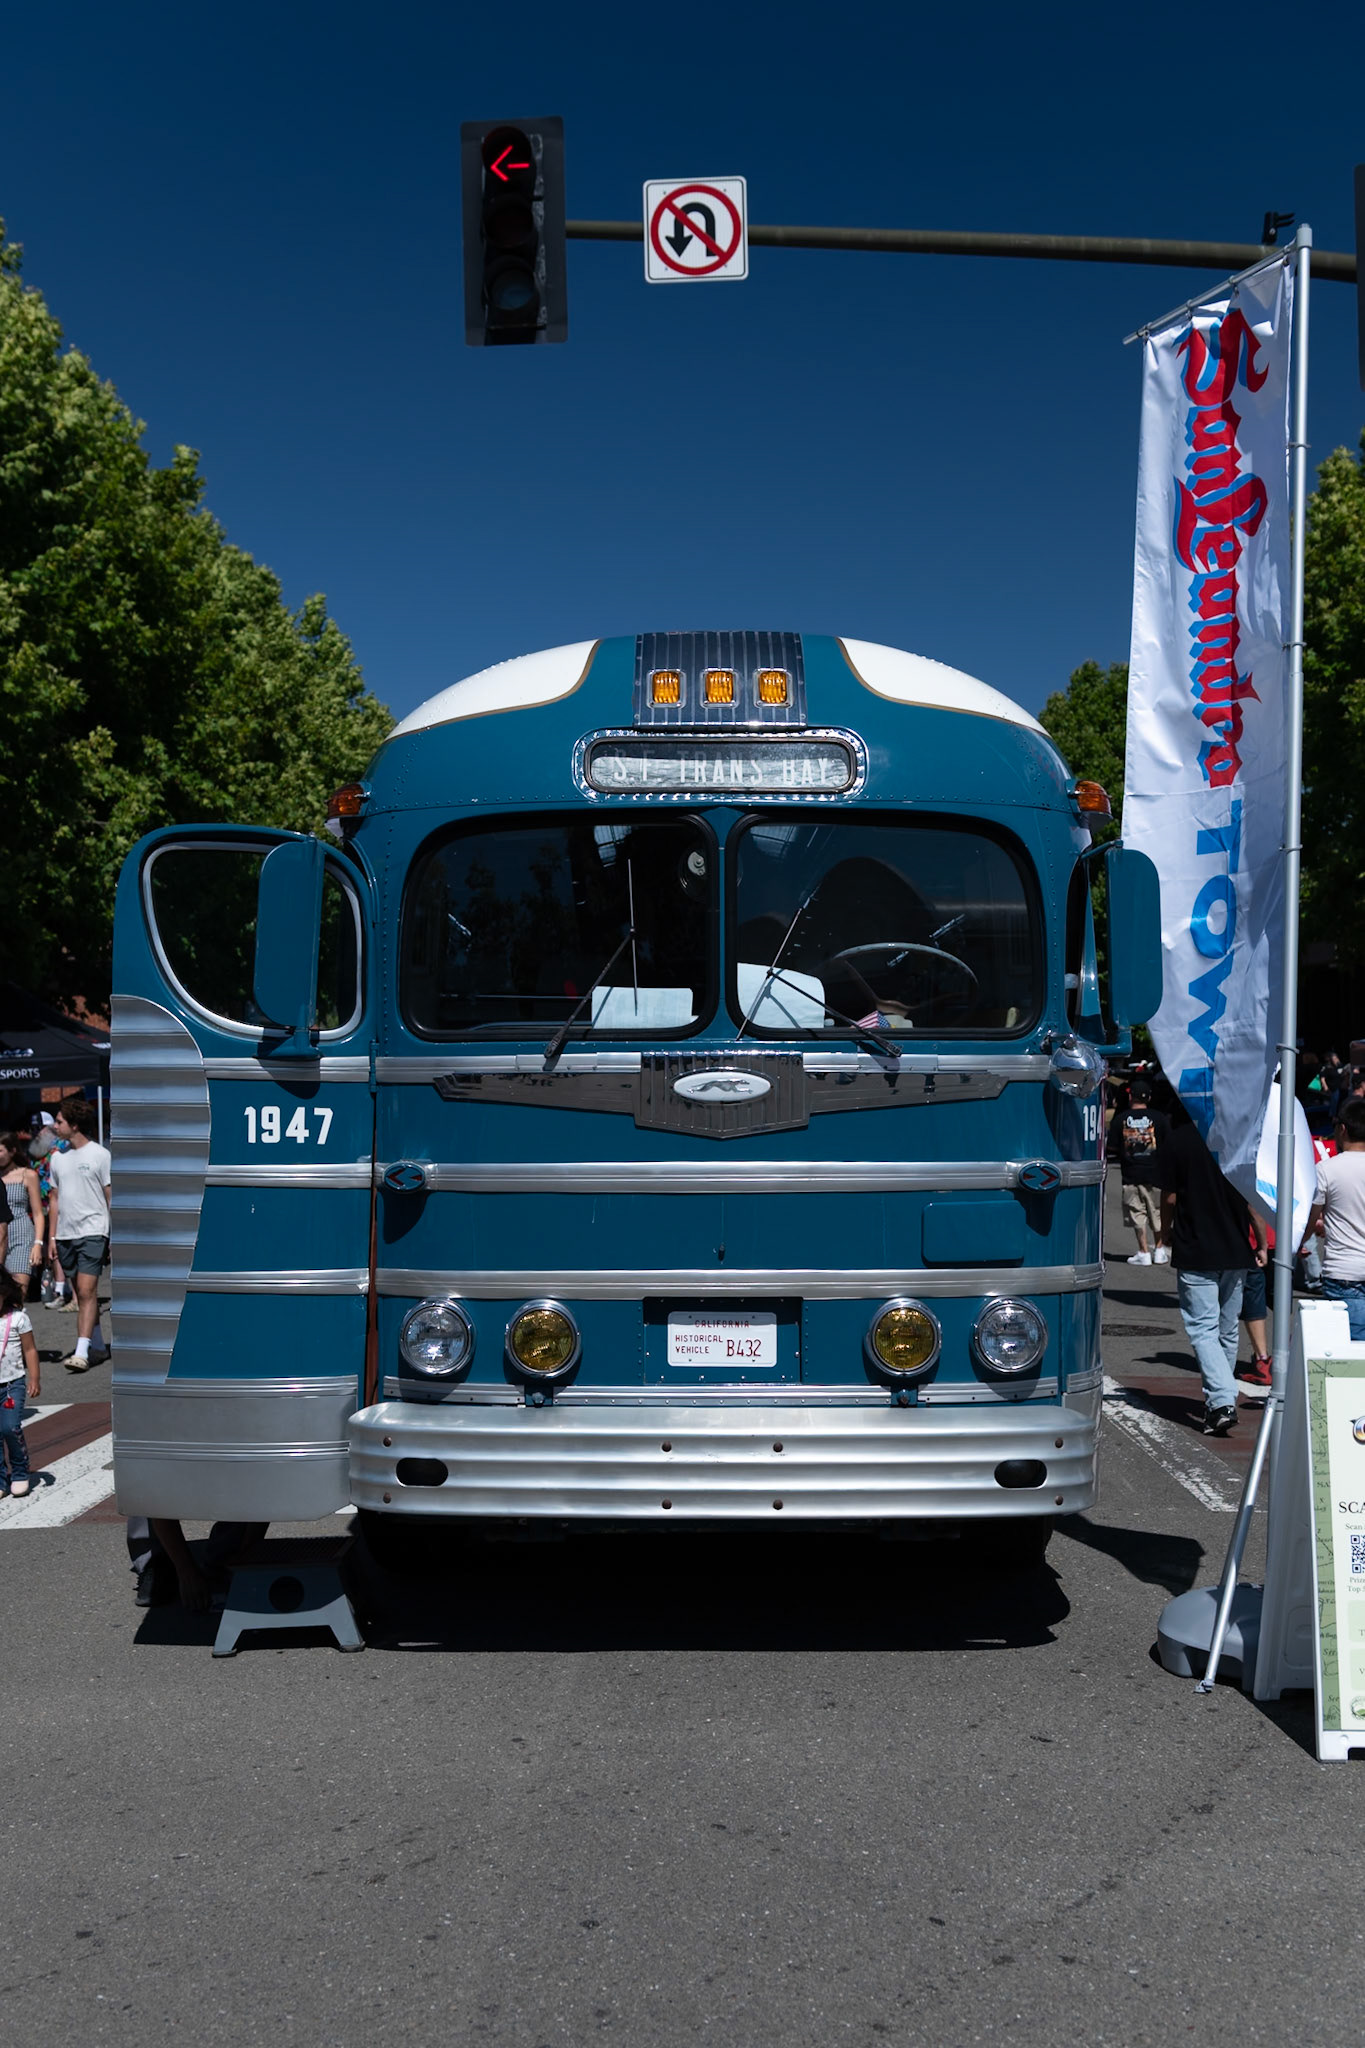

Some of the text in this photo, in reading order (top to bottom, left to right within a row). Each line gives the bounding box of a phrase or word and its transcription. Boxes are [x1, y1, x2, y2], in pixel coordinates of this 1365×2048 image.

[676, 750, 764, 785] TRANS
[782, 751, 829, 785] BAY
[243, 1105, 334, 1145] 1947
[694, 1319, 750, 1328] CALIFORNIA
[675, 1334, 724, 1343] HISTORICAL
[675, 1346, 710, 1354] VEHICLE
[726, 1339, 762, 1357] B432
